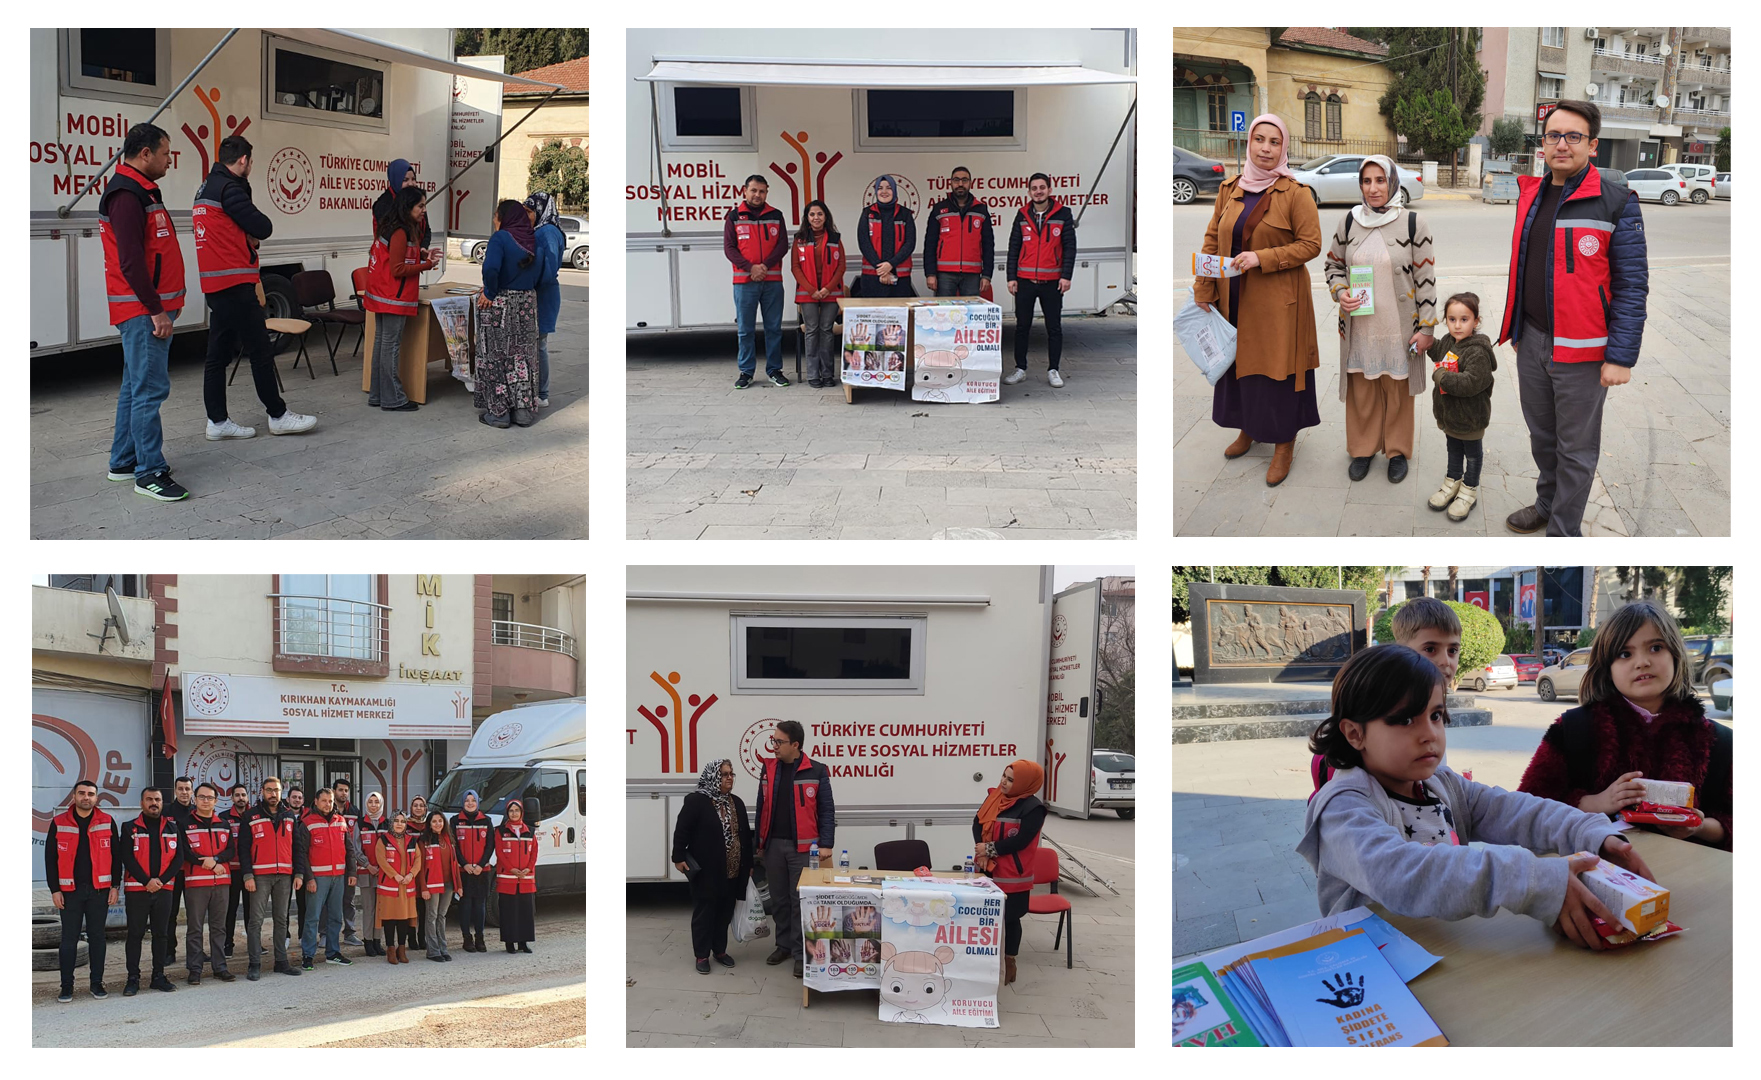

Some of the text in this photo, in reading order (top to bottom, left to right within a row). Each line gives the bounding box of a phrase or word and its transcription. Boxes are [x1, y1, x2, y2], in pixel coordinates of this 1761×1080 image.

[1234, 114, 1243, 131] P
[320, 153, 361, 170] TÜRKİYE
[667, 160, 726, 178] MOBİL
[320, 174, 341, 189] AİLE
[344, 177, 355, 190] VE
[626, 184, 697, 200] SOSYAL
[320, 196, 372, 210] BAKANLIĞI
[954, 326, 1000, 344] AİLESİ
[399, 662, 463, 683] İNŞAAT
[331, 683, 349, 693] T.C.
[280, 694, 396, 707] KIRIKHAN KAYMAKAMLIĞI
[1055, 703, 1078, 713] HİZMET
[282, 707, 394, 719] SOSYAL HİZMET MERKEZİ
[811, 720, 985, 737] TÜRKİYE CUMHURİYETİ
[811, 741, 1017, 757] AİLE VE SOSYAL HİZMETLER
[984, 898, 1001, 907] HER
[979, 916, 995, 926] BİR
[935, 921, 999, 946] AİLESİ
[965, 946, 998, 956] OLMALI
[952, 999, 993, 1008] KORUYUCU
[952, 1008, 994, 1017] AİLE EĞİTİMİ
[1336, 1003, 1382, 1024] KADINA
[1341, 1012, 1389, 1035] ŞİDDETE
[1346, 1022, 1396, 1045] SIFIR
